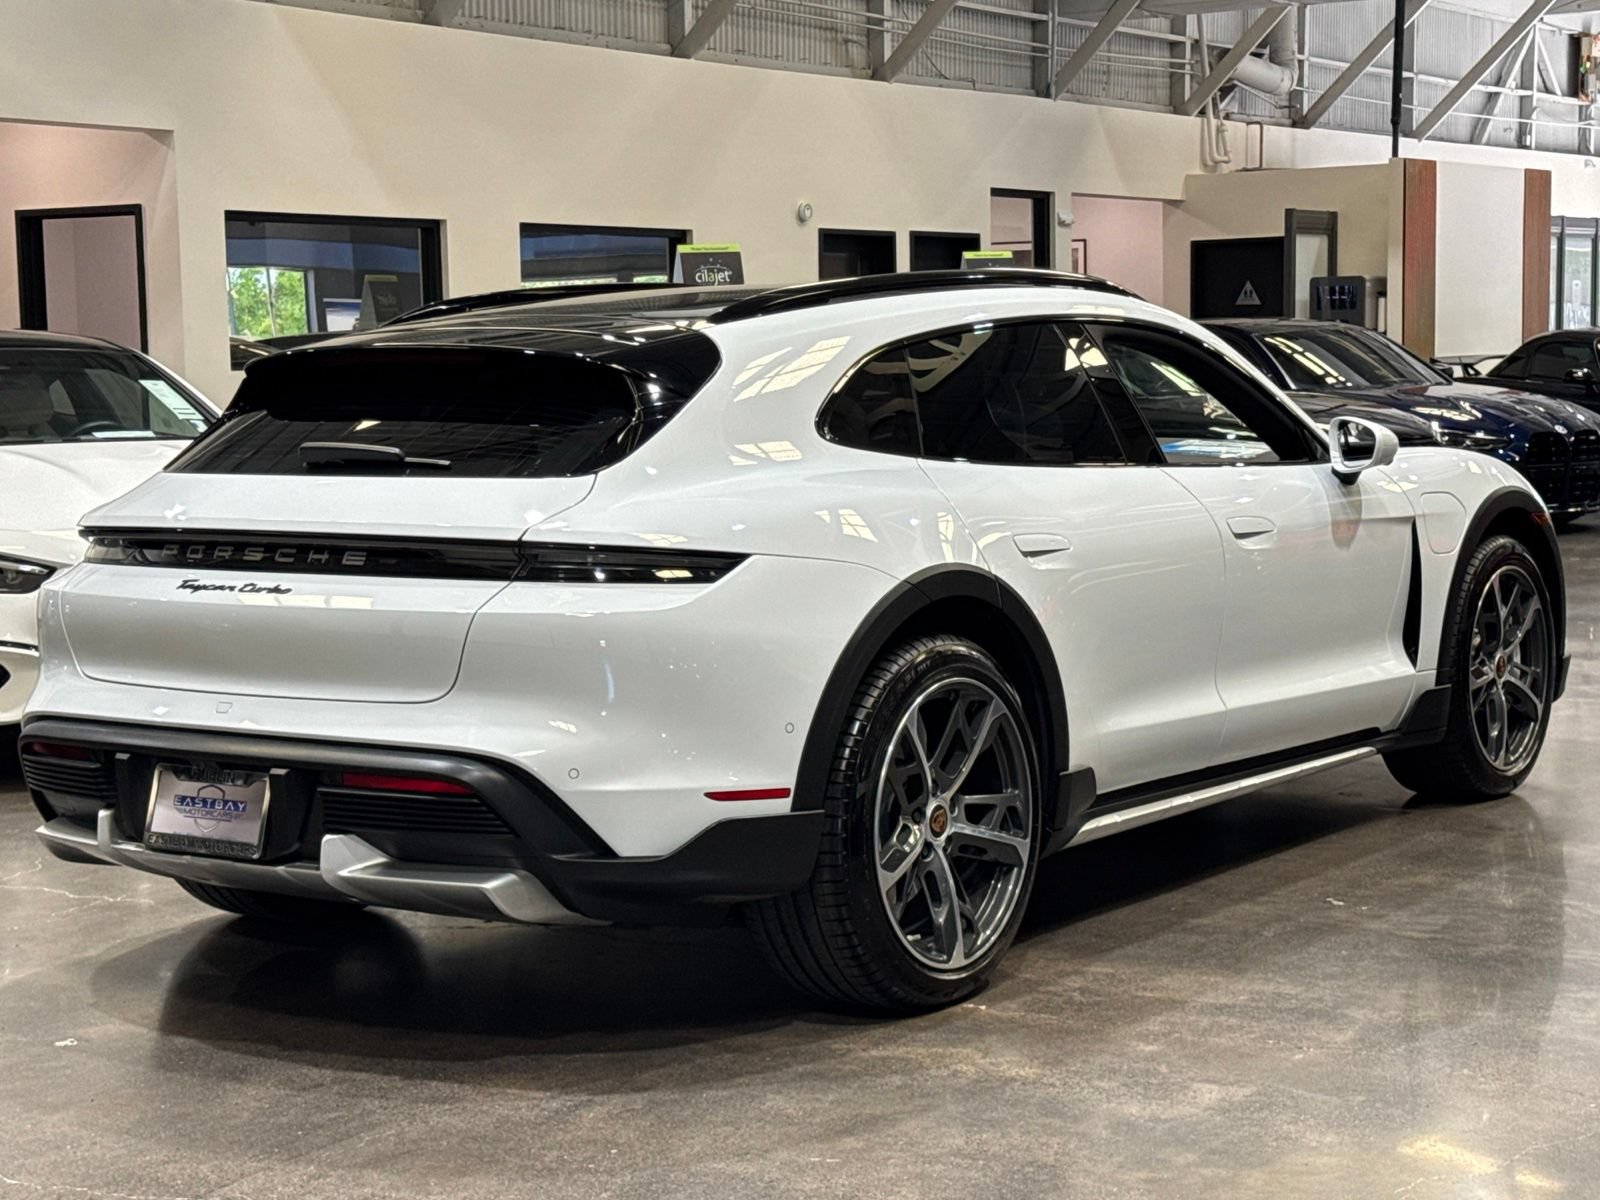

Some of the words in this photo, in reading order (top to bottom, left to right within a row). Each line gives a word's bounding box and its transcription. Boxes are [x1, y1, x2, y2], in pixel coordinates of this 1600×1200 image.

[695, 268, 731, 286] cilajet
[160, 543, 368, 566] PORSCHE
[176, 579, 237, 594] Taycan
[174, 796, 246, 811] EASTBAY
[183, 807, 233, 819] MOTORCARS
